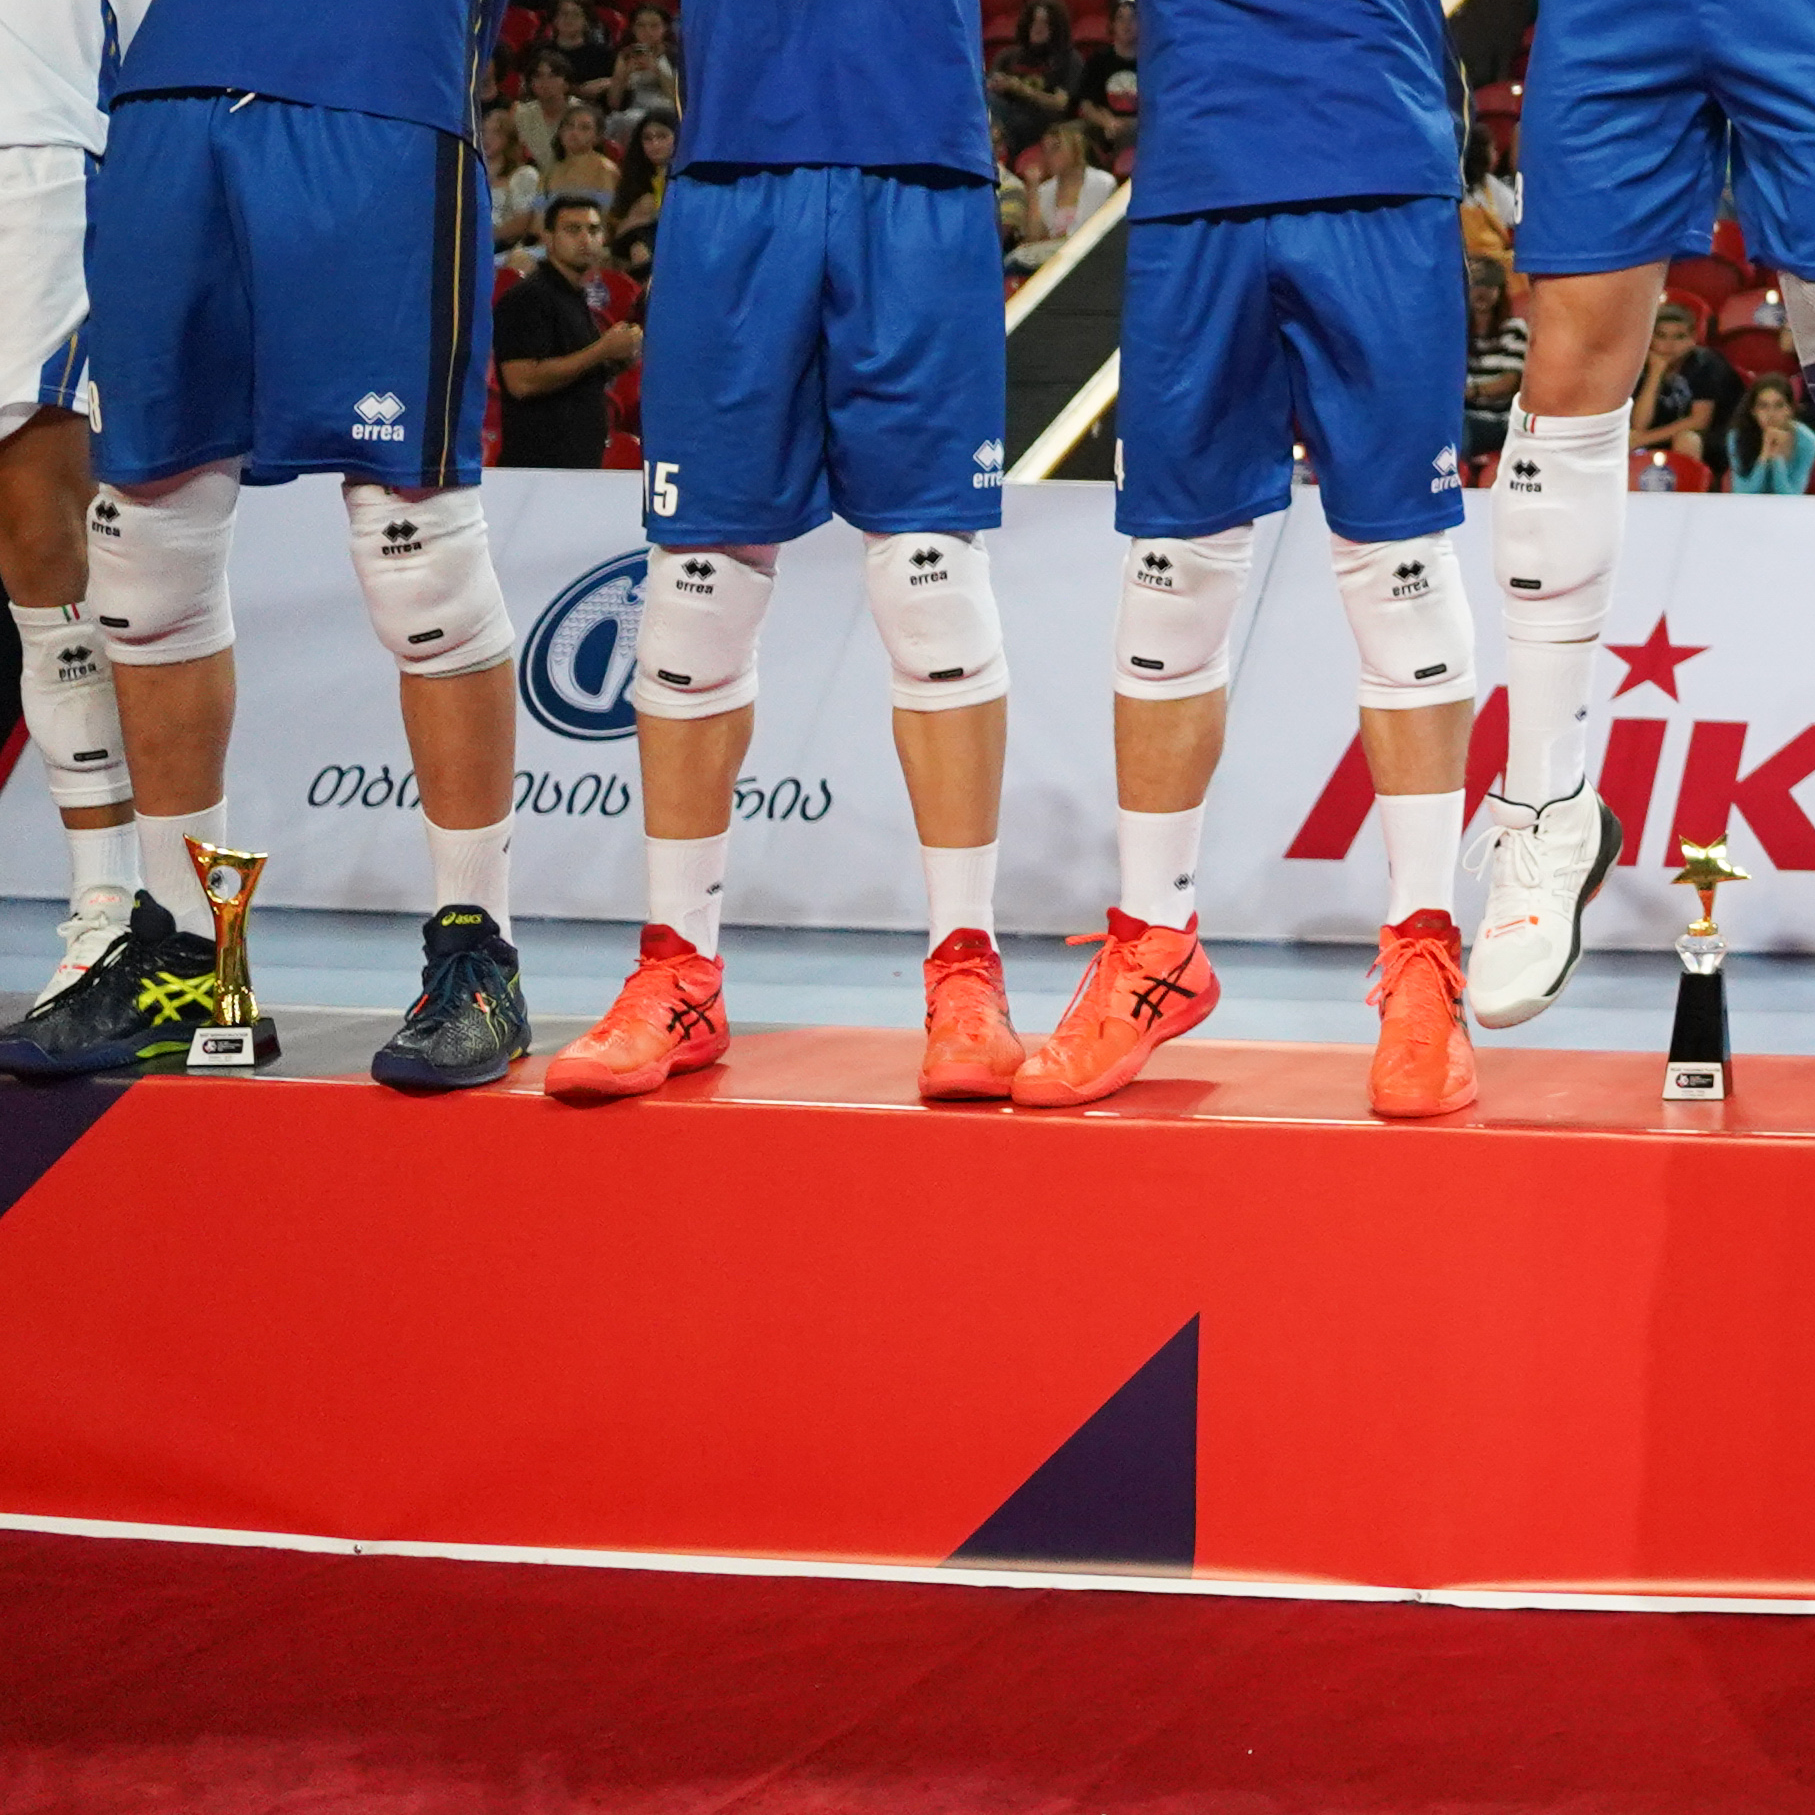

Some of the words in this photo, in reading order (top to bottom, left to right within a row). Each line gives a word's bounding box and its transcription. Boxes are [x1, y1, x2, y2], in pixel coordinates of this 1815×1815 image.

[352, 423, 405, 442] errea
[1509, 480, 1542, 494] errea
[381, 539, 423, 556] errea
[909, 570, 948, 586] errea
[1137, 569, 1173, 588] errea
[676, 579, 713, 596] errea
[1392, 578, 1429, 596] errea
